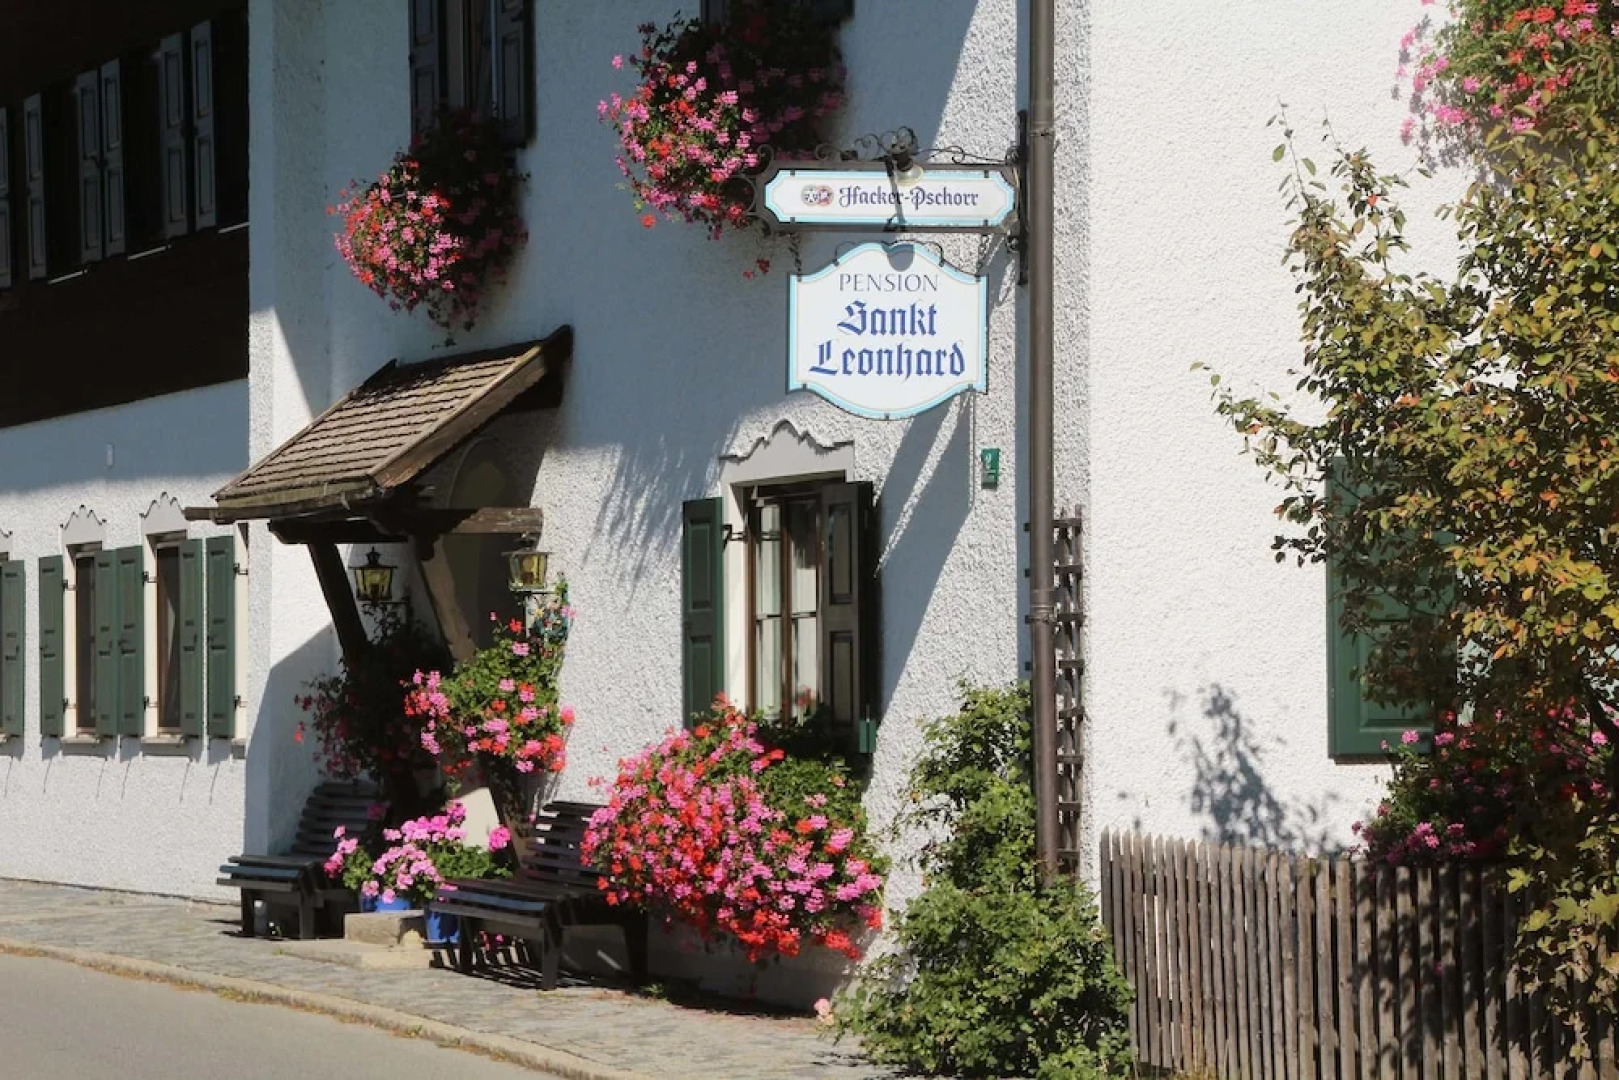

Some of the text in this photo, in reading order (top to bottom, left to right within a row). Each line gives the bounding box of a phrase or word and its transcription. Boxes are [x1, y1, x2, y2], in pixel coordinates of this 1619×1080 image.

[839, 185, 979, 211] Hacker-Pschorr
[839, 273, 938, 292] PENSION
[837, 300, 937, 336] Sankt
[808, 339, 966, 383] Leonhard
